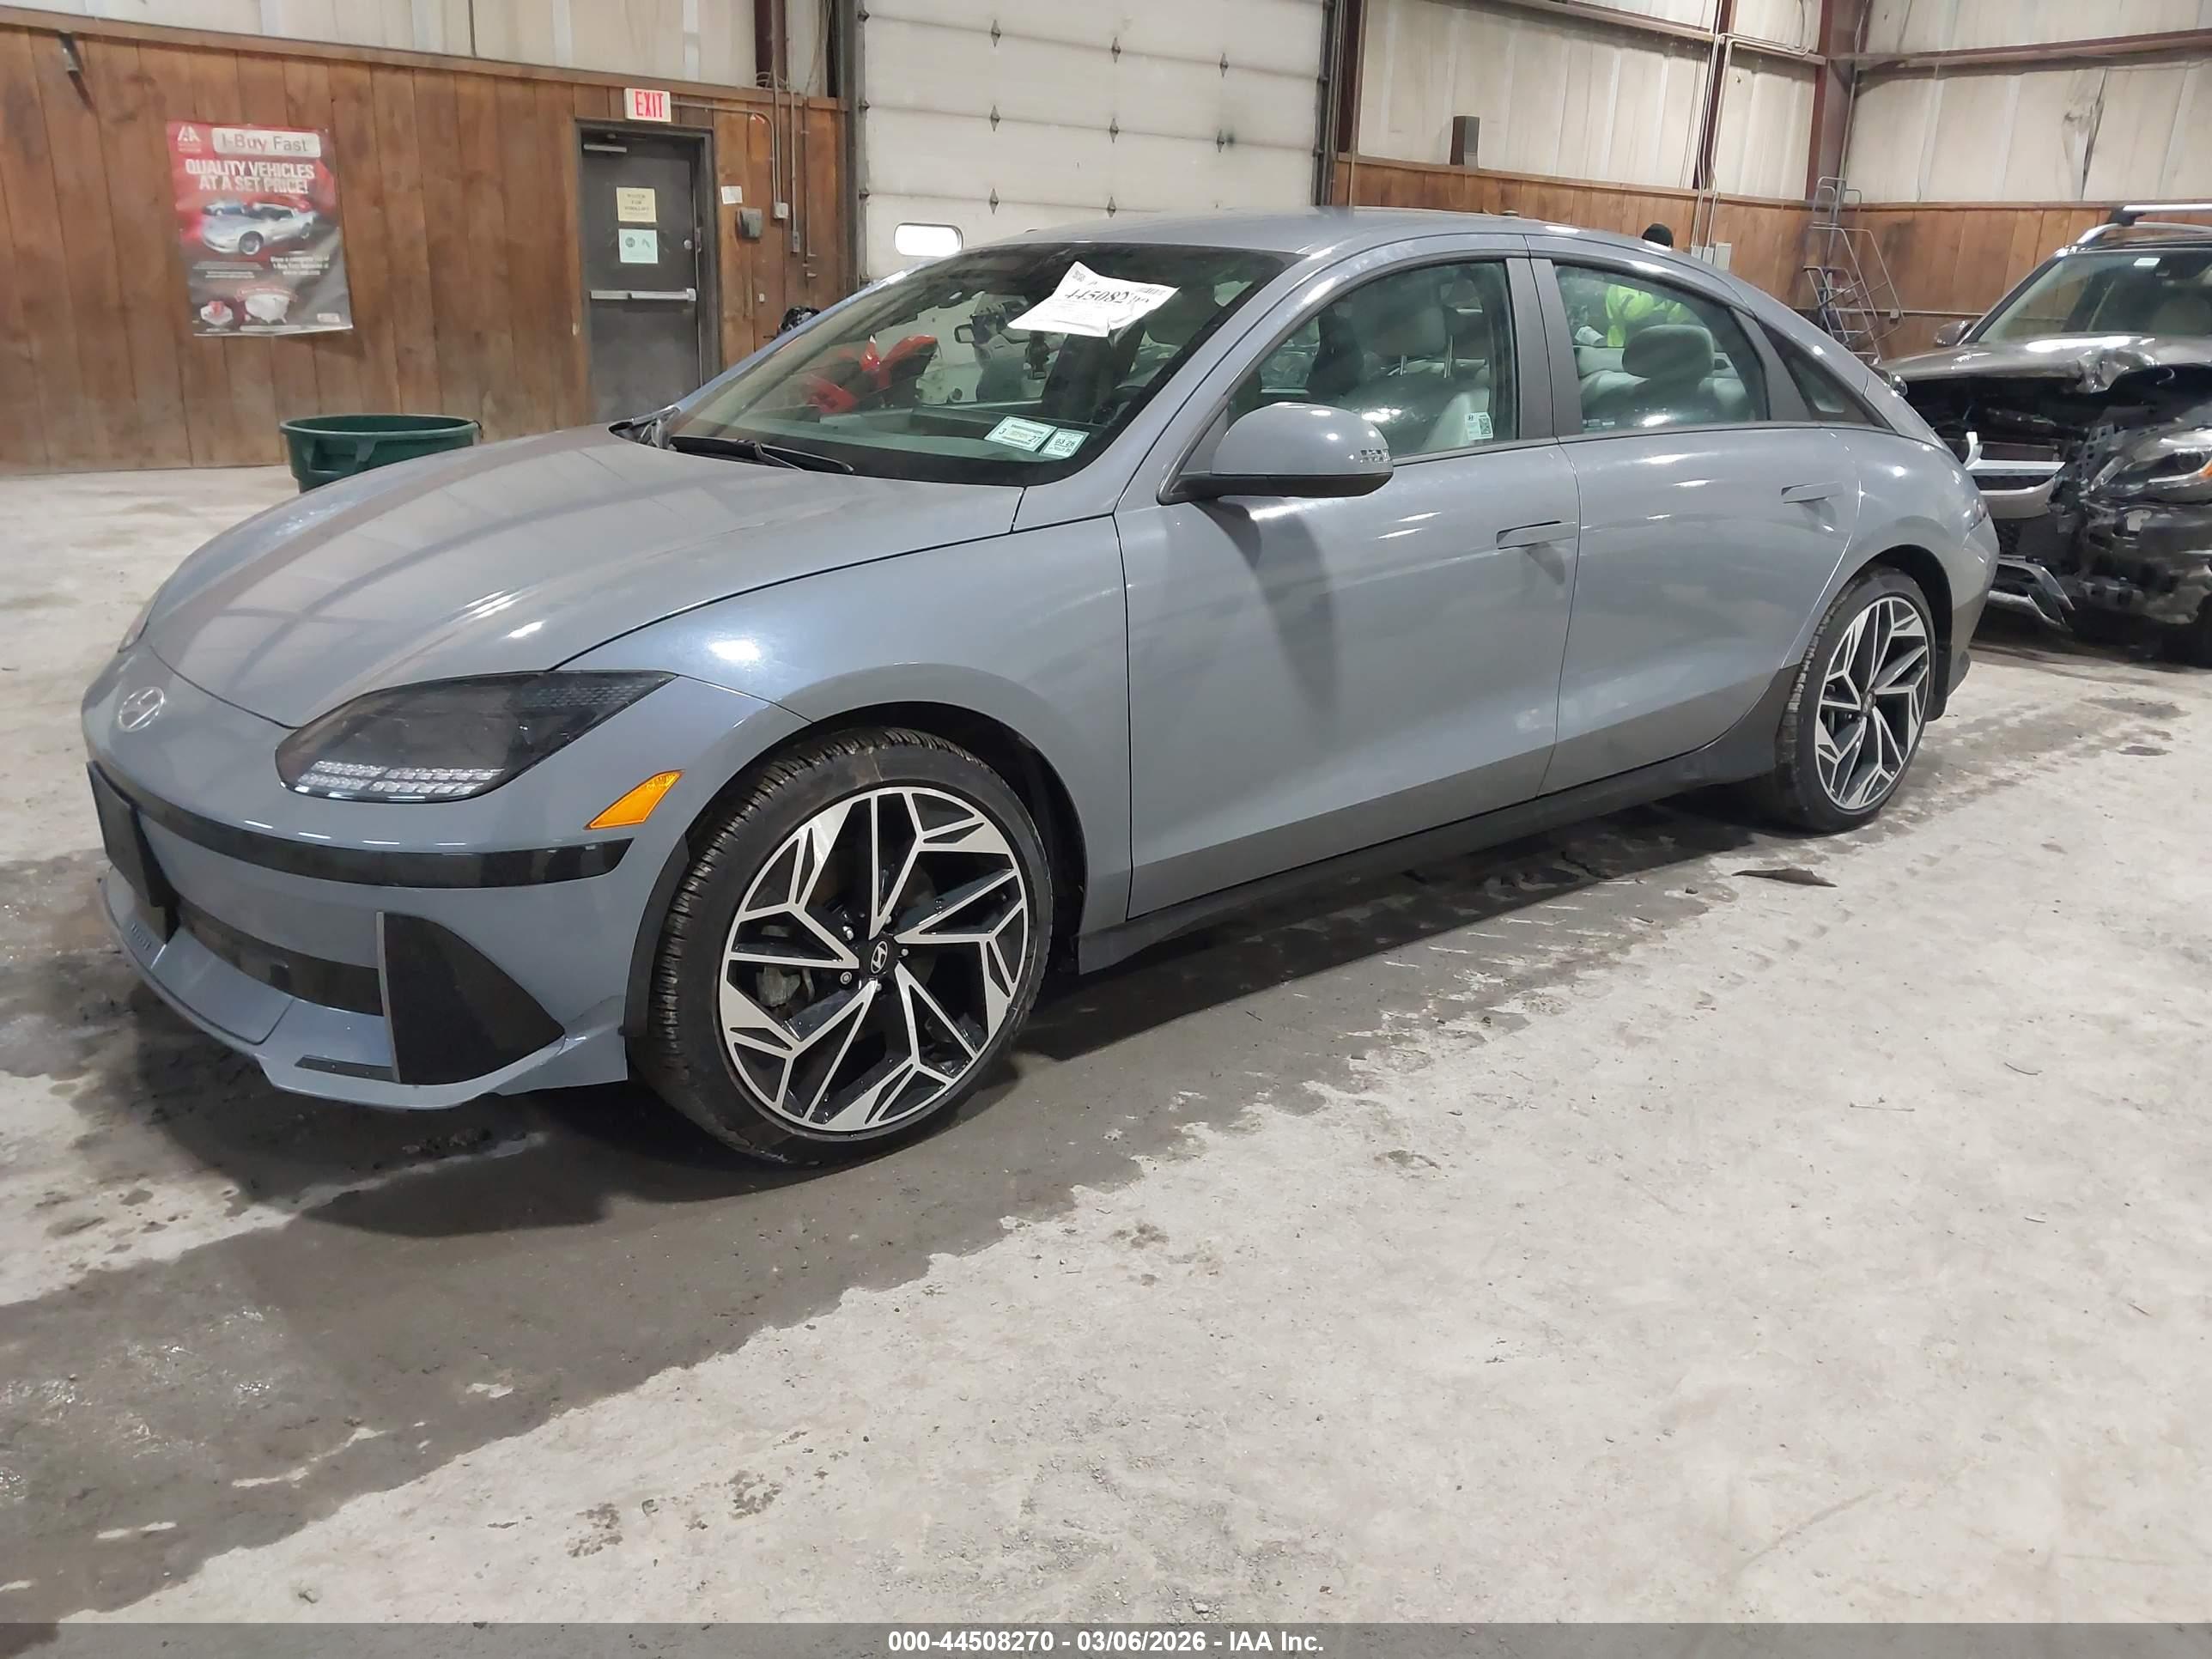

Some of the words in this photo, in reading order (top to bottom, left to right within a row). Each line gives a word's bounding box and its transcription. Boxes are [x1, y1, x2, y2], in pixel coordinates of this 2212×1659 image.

[635, 91, 664, 118] EXIT
[222, 134, 268, 152] I-Buy
[273, 136, 308, 152] Fast
[185, 159, 246, 176] QUALITY
[248, 161, 314, 179] VEHICLES
[199, 174, 221, 190] AT
[222, 175, 234, 191] A
[234, 176, 258, 192] SET
[264, 179, 308, 194] PRICE!
